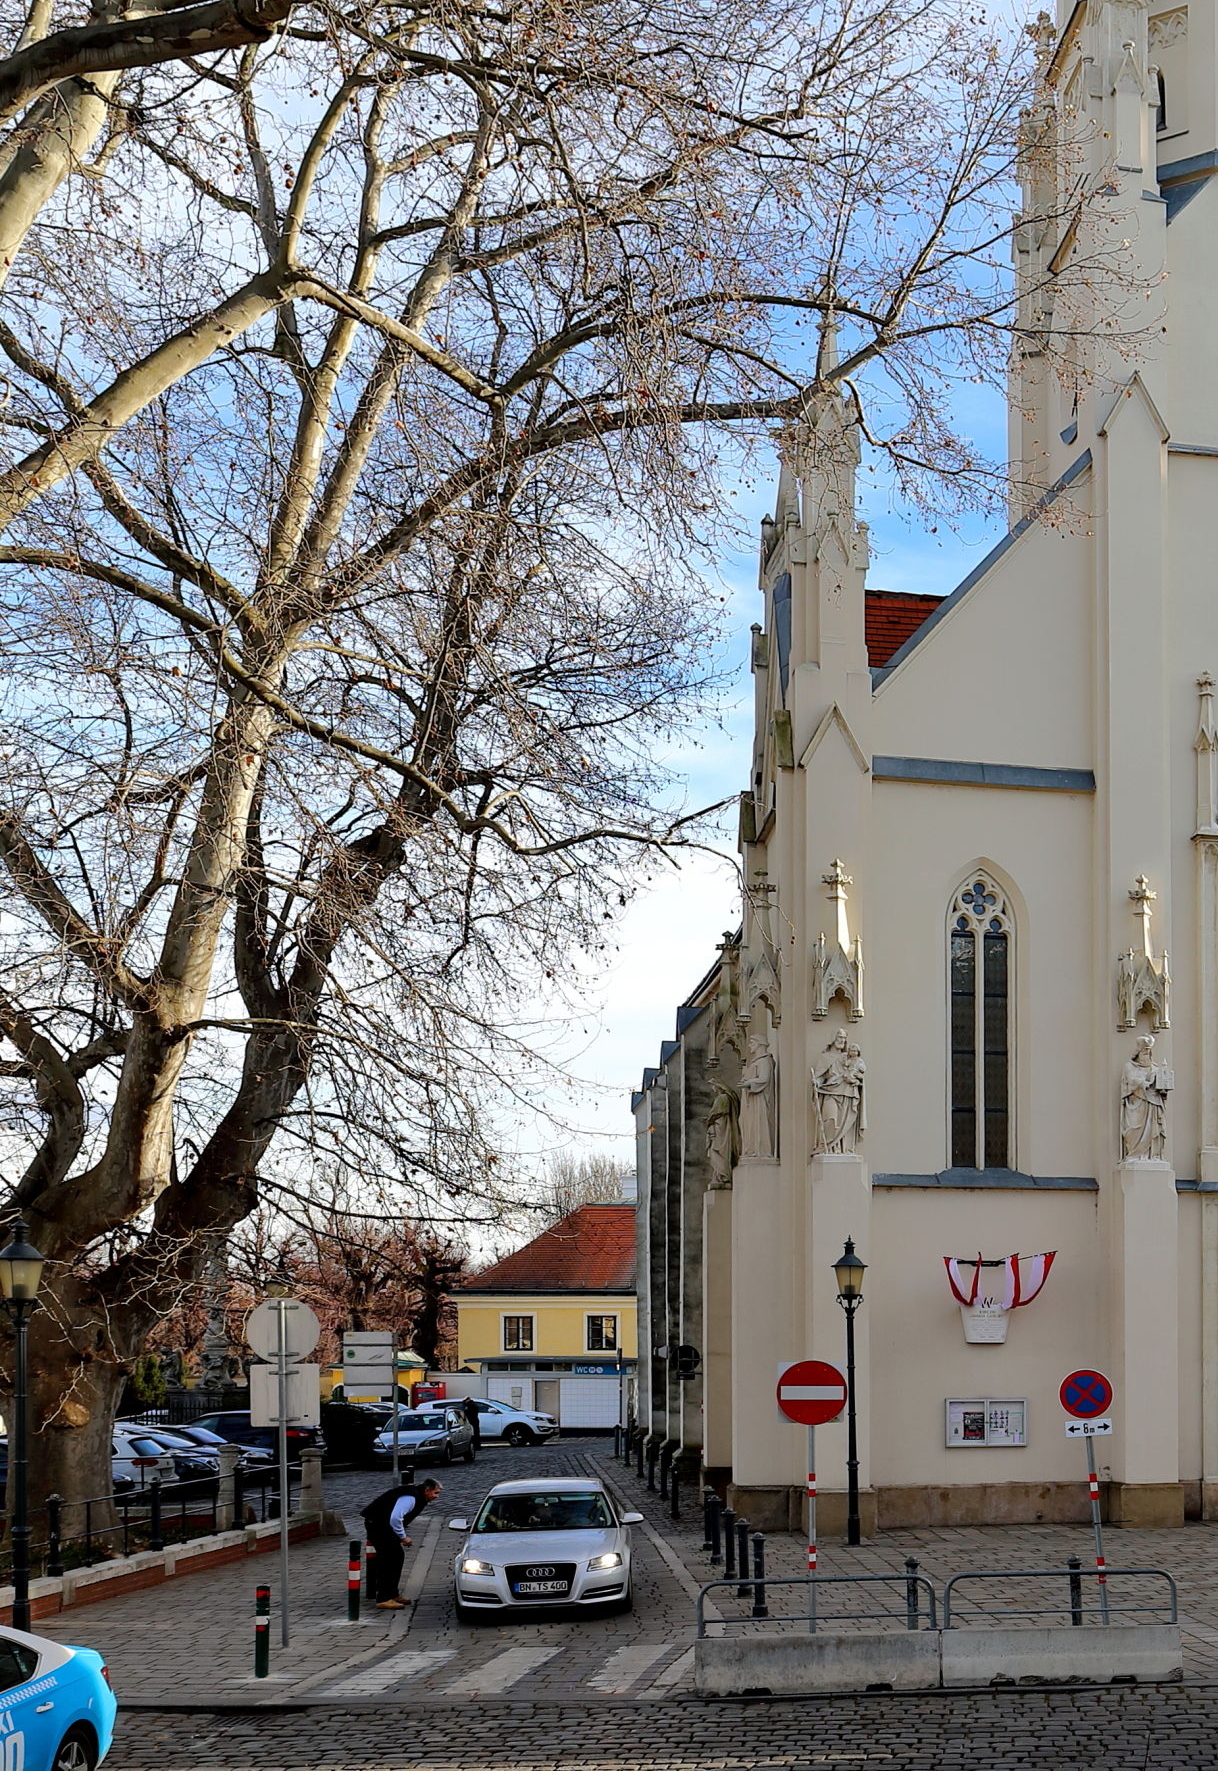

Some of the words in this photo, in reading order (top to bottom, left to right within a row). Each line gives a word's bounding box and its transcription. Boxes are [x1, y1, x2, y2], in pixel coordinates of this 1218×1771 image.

[576, 1366, 588, 1374] WC
[519, 1583, 532, 1591] BN
[537, 1582, 549, 1591] TS
